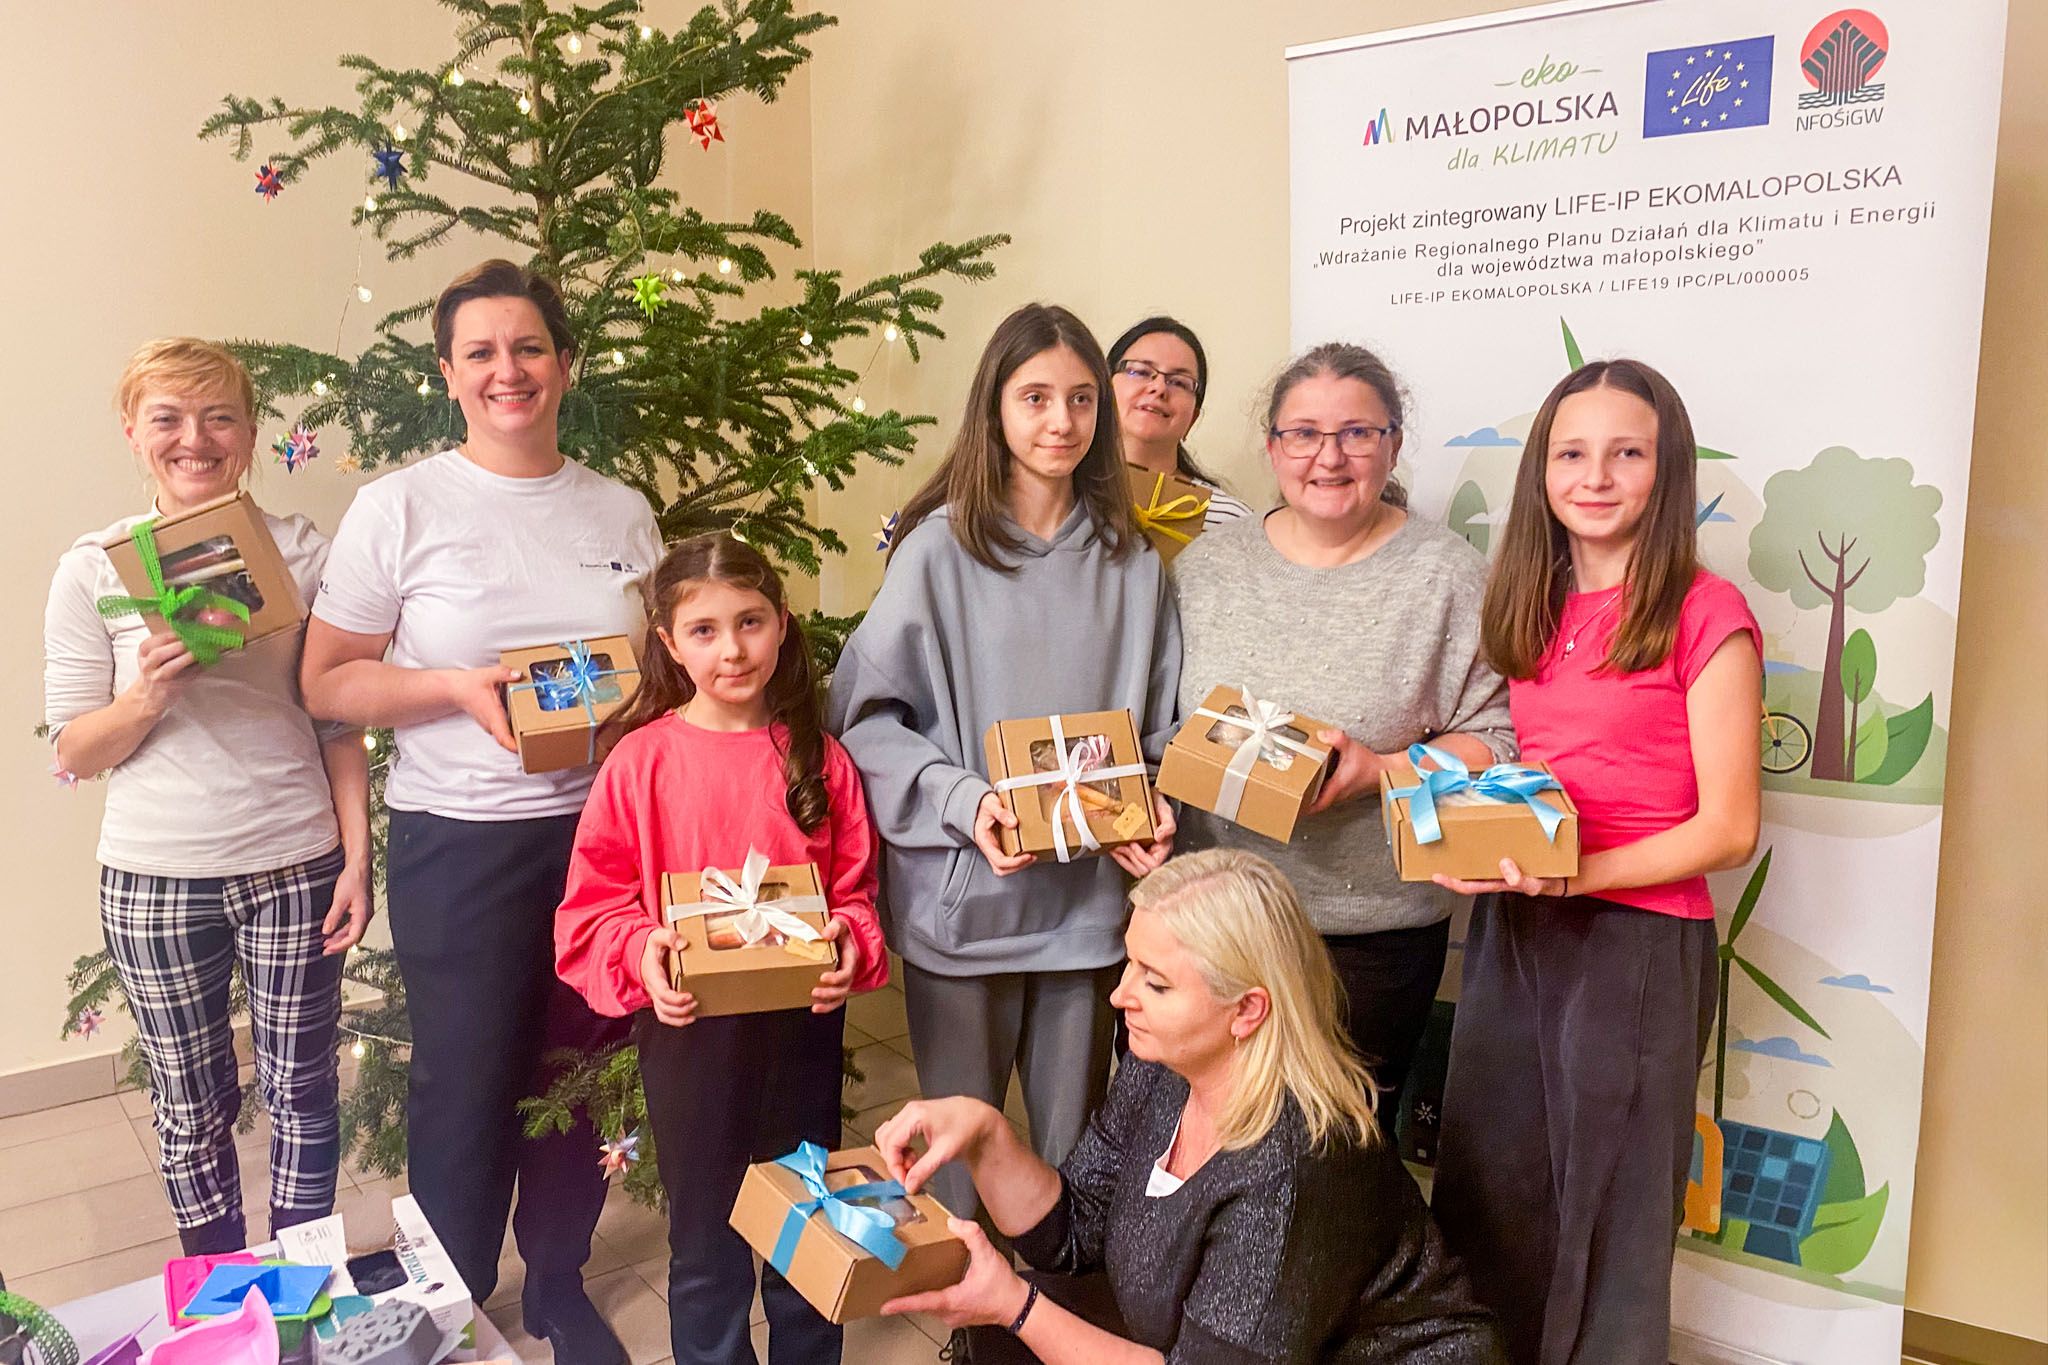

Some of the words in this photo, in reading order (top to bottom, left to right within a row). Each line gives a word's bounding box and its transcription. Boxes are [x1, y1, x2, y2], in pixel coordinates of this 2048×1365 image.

[1520, 53, 1580, 88] eko
[1681, 64, 1732, 107] Life
[1405, 91, 1619, 142] MAŁOPOLSKA
[1796, 107, 1884, 131] NFOŚiGW
[1446, 147, 1481, 171] dla
[1492, 131, 1619, 166] KLIMATU
[1340, 212, 1406, 237] Projekt
[1412, 201, 1547, 229] zintegrowany
[1555, 190, 1640, 216] LIFE-IP
[1648, 165, 1903, 208] EKOMALOPOLSKA
[1415, 237, 1539, 261] Regionalnego
[1547, 232, 1602, 248] Planu
[1611, 222, 1688, 243] Działań
[1697, 220, 1729, 237] dla
[1739, 212, 1823, 233] Klimatu
[1834, 210, 1839, 226] i
[1850, 201, 1936, 225] Energii
[1437, 261, 1463, 277] dla
[1471, 254, 1593, 277] województwa
[1390, 291, 1445, 305] LIFE-IP
[1451, 281, 1592, 302] EKOMALOPOLSKA
[1611, 276, 1669, 292] LIFE19
[1677, 267, 1809, 288] IPC/PL/000005
